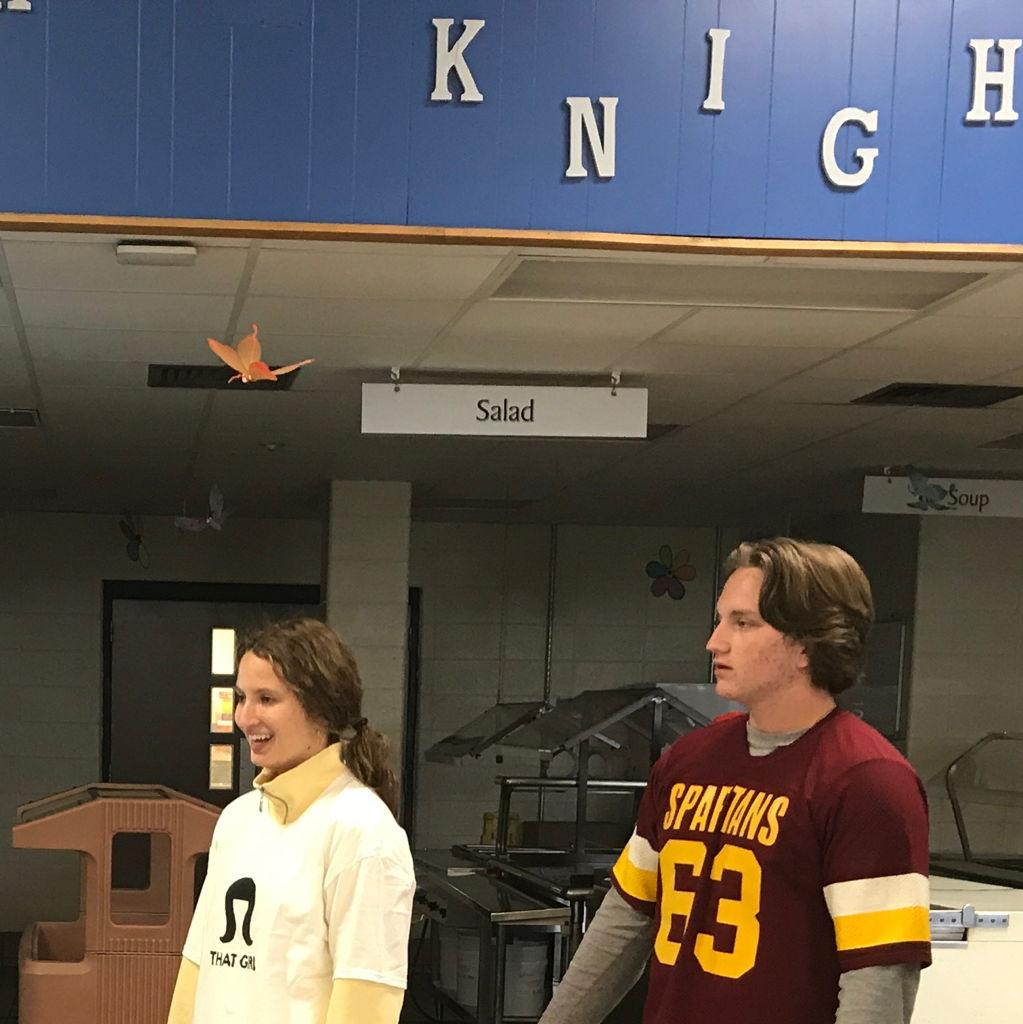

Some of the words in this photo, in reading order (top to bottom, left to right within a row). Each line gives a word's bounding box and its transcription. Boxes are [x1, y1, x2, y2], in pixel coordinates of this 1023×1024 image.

[476, 398, 534, 422] Salad
[947, 484, 990, 512] Soup
[654, 839, 762, 979] 63
[210, 950, 238, 968] THAT
